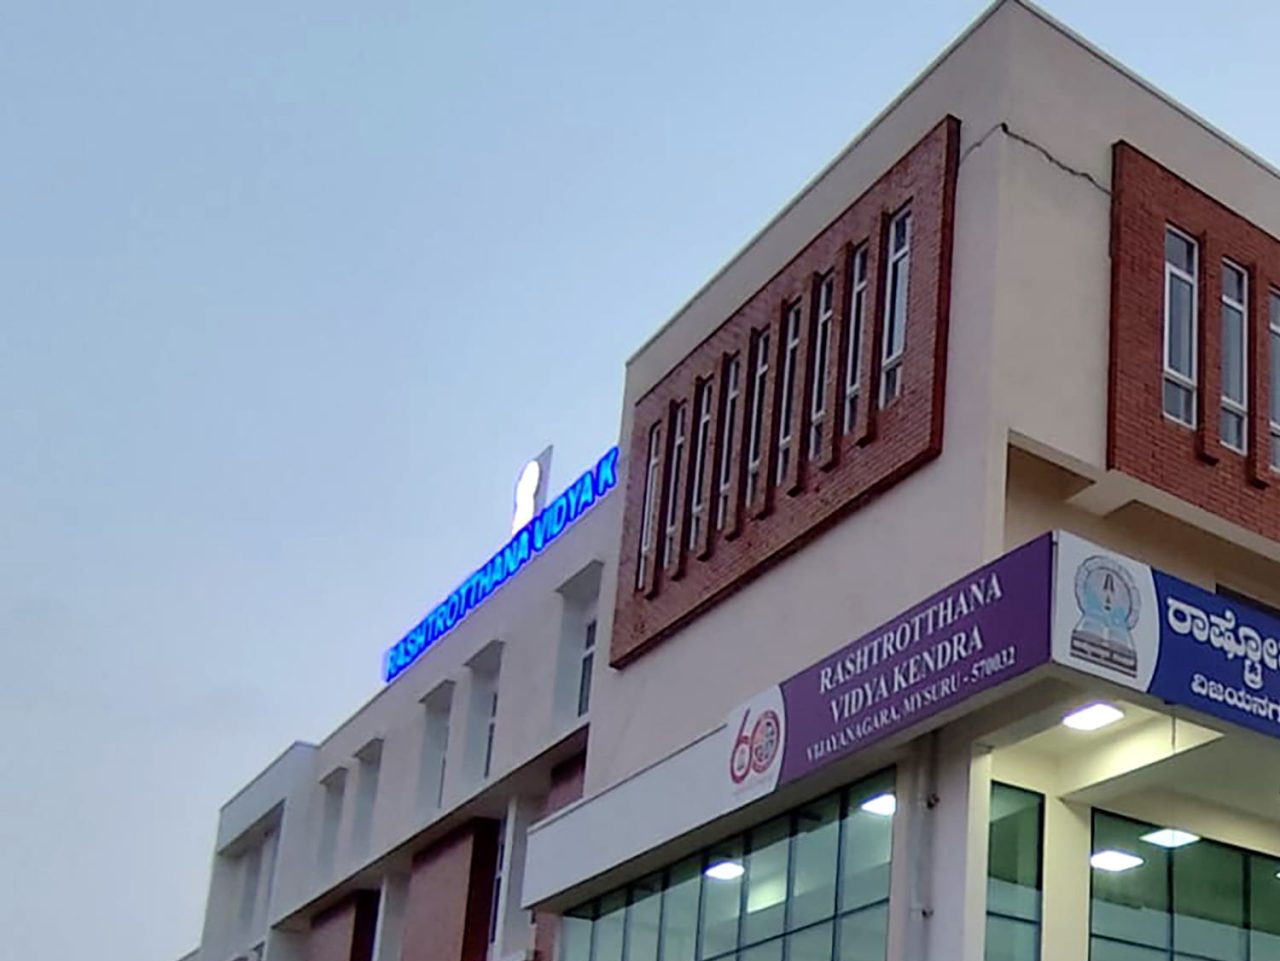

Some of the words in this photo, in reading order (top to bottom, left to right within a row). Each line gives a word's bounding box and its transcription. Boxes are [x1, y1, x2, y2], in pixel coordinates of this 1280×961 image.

[532, 470, 595, 553] VIDYA
[819, 572, 1002, 694] RASHTROTTHANA
[830, 677, 888, 724] VIDYA
[892, 625, 984, 693] KENDRA
[902, 672, 960, 716] MYSURU
